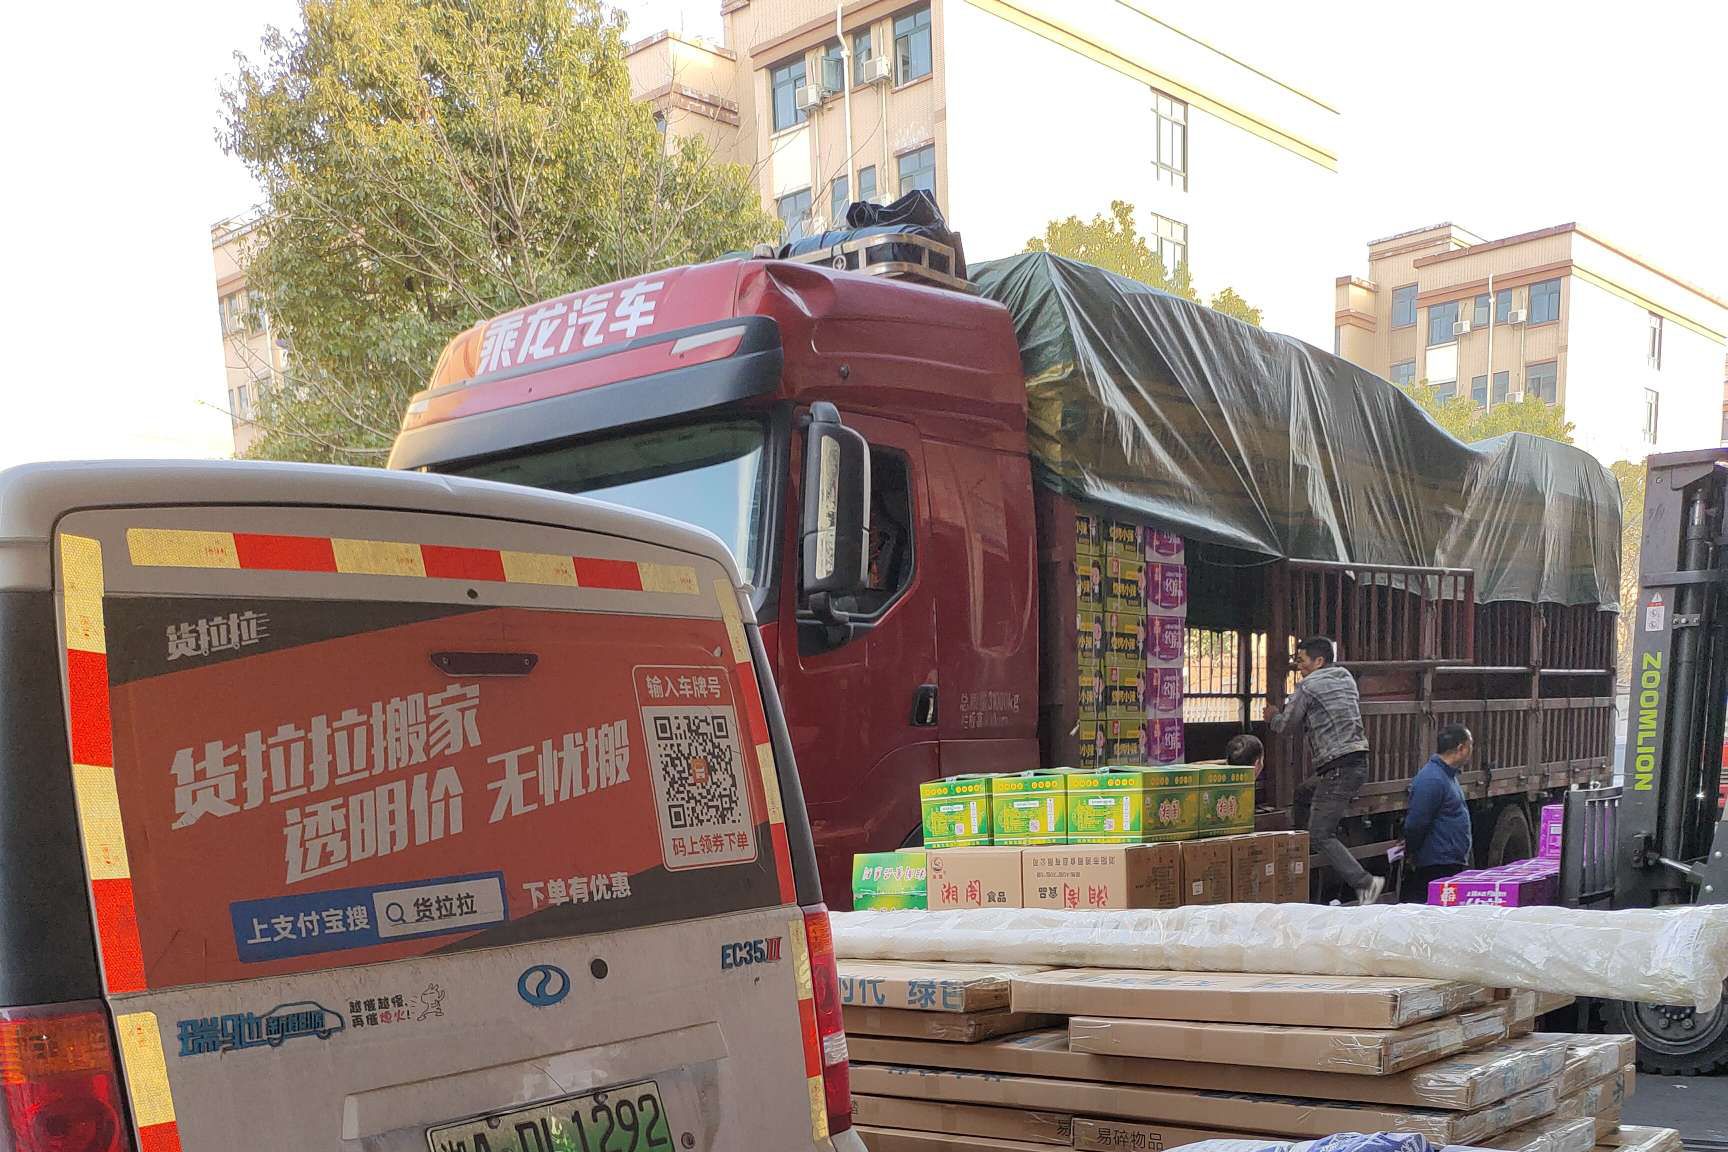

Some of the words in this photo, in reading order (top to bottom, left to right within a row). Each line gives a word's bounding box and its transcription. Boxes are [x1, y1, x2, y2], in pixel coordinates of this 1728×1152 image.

[477, 280, 664, 375] 乘龙汽车
[166, 610, 268, 661] 货拉拉
[646, 675, 721, 699] 输入车牌号
[1634, 651, 1661, 791] ZOOMLION
[170, 684, 482, 830] 货拉拉搬家
[284, 766, 464, 885] 透明价
[487, 719, 631, 824] 无忧搬
[672, 831, 749, 856] 码上领券下单
[523, 871, 632, 909] 下单有优惠
[987, 890, 1006, 903] 食品
[247, 904, 370, 945] 上支付宝搜
[413, 893, 478, 923] 货拉拉
[1097, 1128, 1163, 1151] 易碎物品
